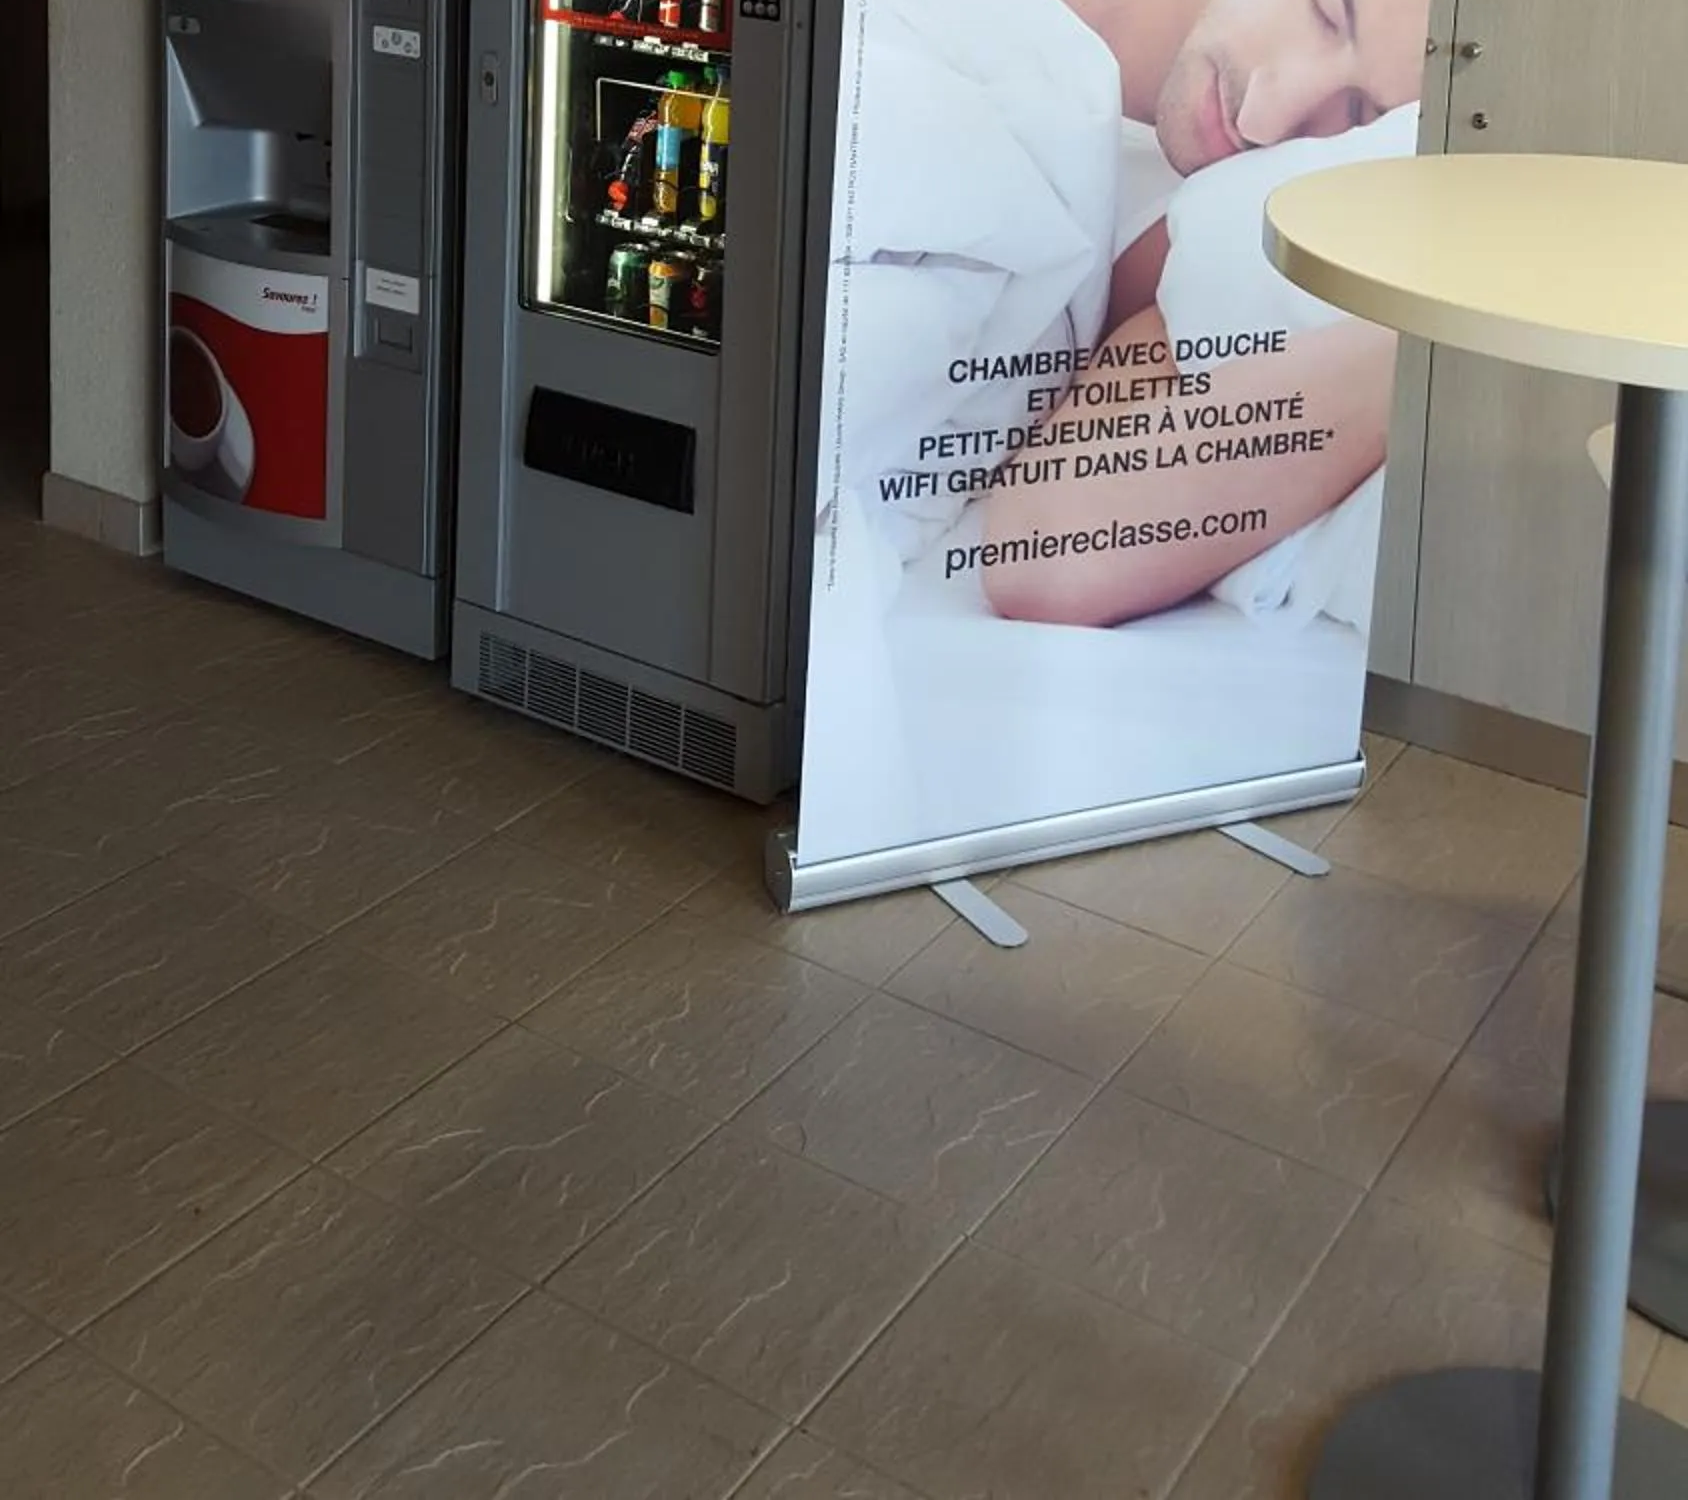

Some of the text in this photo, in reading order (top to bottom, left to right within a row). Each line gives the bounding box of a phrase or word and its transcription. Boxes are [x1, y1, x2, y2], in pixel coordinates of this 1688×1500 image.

[948, 330, 1287, 385] CHAMBRE AVEC DOUCHE
[1027, 372, 1211, 413] ET TOILETTES
[919, 391, 1305, 461] PETIT-DÉJEUNER À VOLONTÉ
[879, 472, 938, 502] WIFI
[947, 459, 1067, 494] GRATUIT
[1075, 451, 1148, 480] DANS
[1156, 446, 1189, 470] LA
[945, 507, 1269, 579] premiereclasse.com
